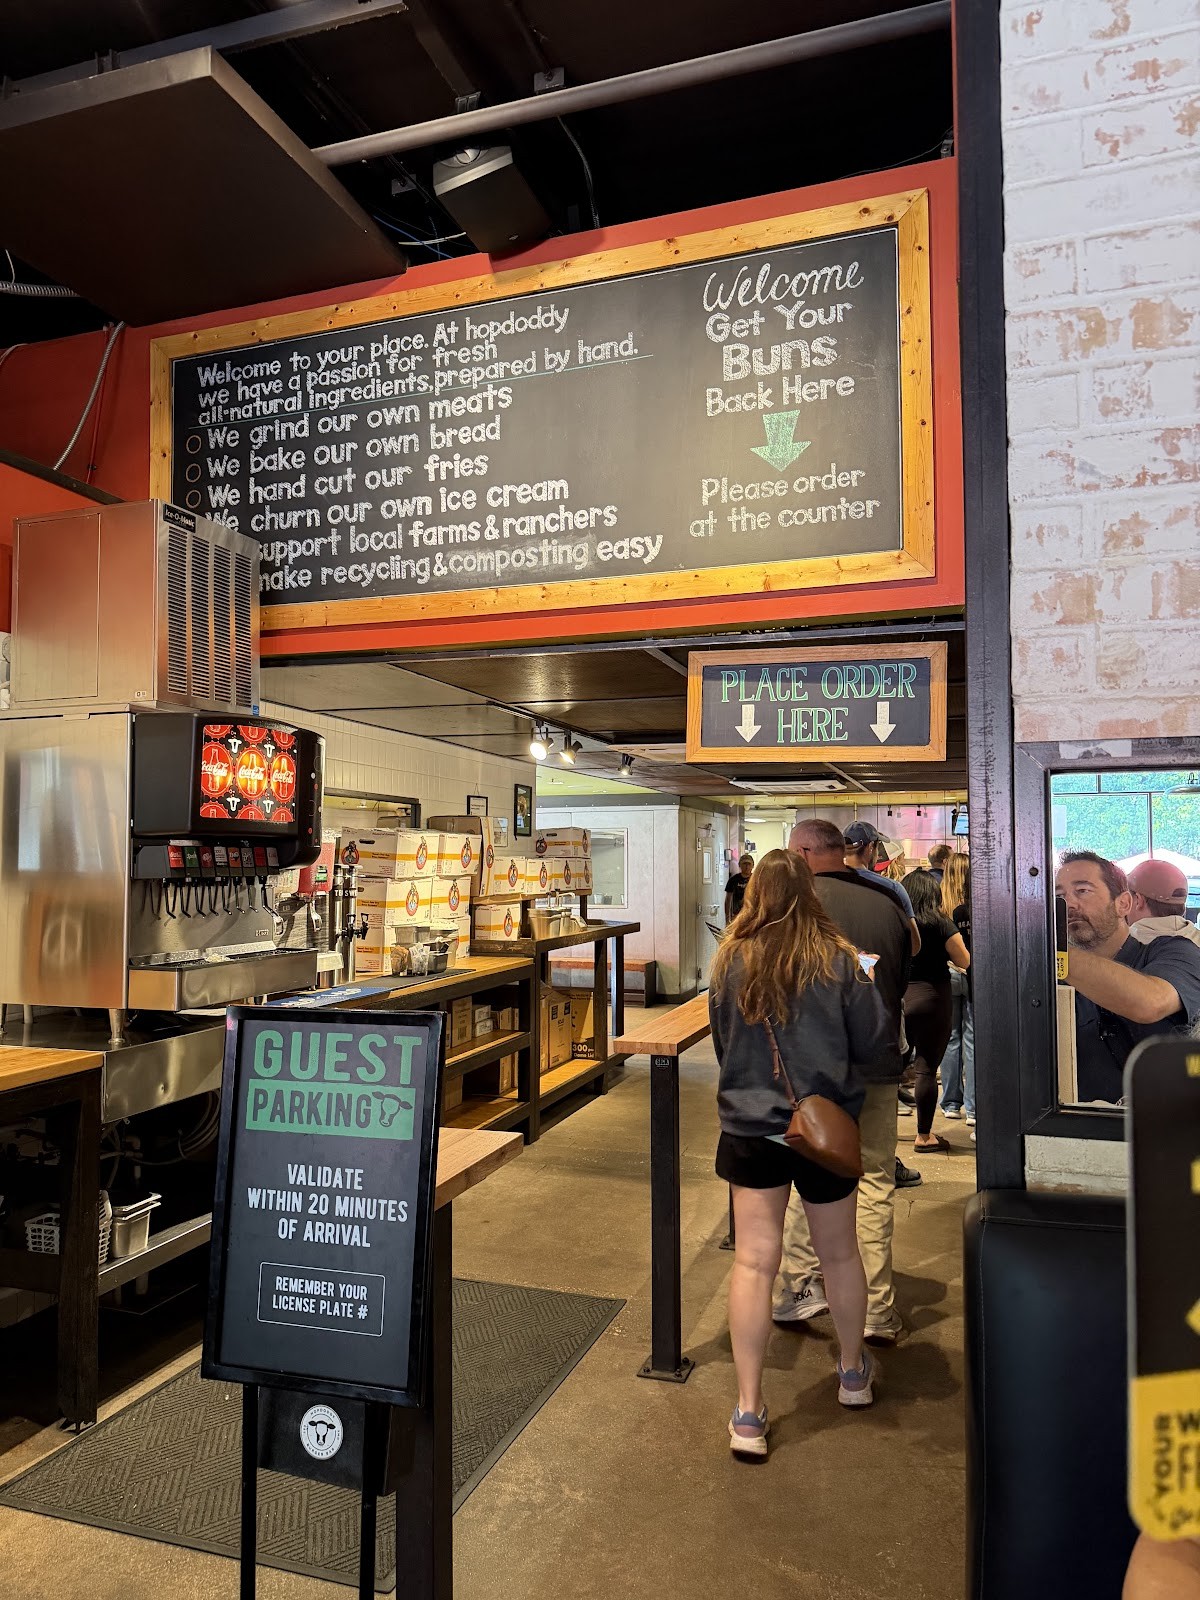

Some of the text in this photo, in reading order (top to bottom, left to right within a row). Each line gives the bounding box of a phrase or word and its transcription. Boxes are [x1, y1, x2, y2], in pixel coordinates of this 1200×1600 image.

[703, 261, 865, 312] Welcome
[705, 300, 854, 343] Get Your
[197, 304, 569, 388] Welcome to your place. At hopdoddy
[434, 351, 537, 396] prepared
[544, 347, 571, 373] by
[577, 332, 639, 365] hand.
[722, 335, 838, 382] Buns
[198, 339, 498, 409] we have a passion for fresh
[706, 374, 855, 417] Back Here
[206, 383, 513, 450] We grind our own meats
[206, 414, 501, 479] We bake our own bread
[207, 452, 489, 509] We hand cut our fries
[701, 462, 866, 507] Please order
[250, 505, 321, 533] churn
[326, 500, 373, 525] our
[380, 495, 433, 520] own
[438, 487, 477, 513] ice
[486, 478, 570, 509] cream
[689, 497, 881, 538] at the counter
[349, 523, 403, 555] local
[408, 520, 481, 546] farms
[484, 514, 501, 542] &
[502, 504, 619, 539] ranchers
[320, 554, 430, 588] recycling
[433, 551, 448, 577] &
[449, 538, 589, 577] composting
[596, 534, 664, 565] easy
[720, 663, 917, 703] PLACE ORDER
[777, 706, 849, 743] HERE
[254, 1029, 423, 1085] GUEST
[252, 1088, 372, 1129] PARKING
[287, 1163, 364, 1191] VALIDATE
[247, 1187, 409, 1223] WITHIN 20 MINUTES
[277, 1217, 371, 1248] OF ARRIVAL
[272, 1294, 369, 1320] LICENSE PLATE #
[275, 1275, 368, 1301] REMEMBER YOUR
